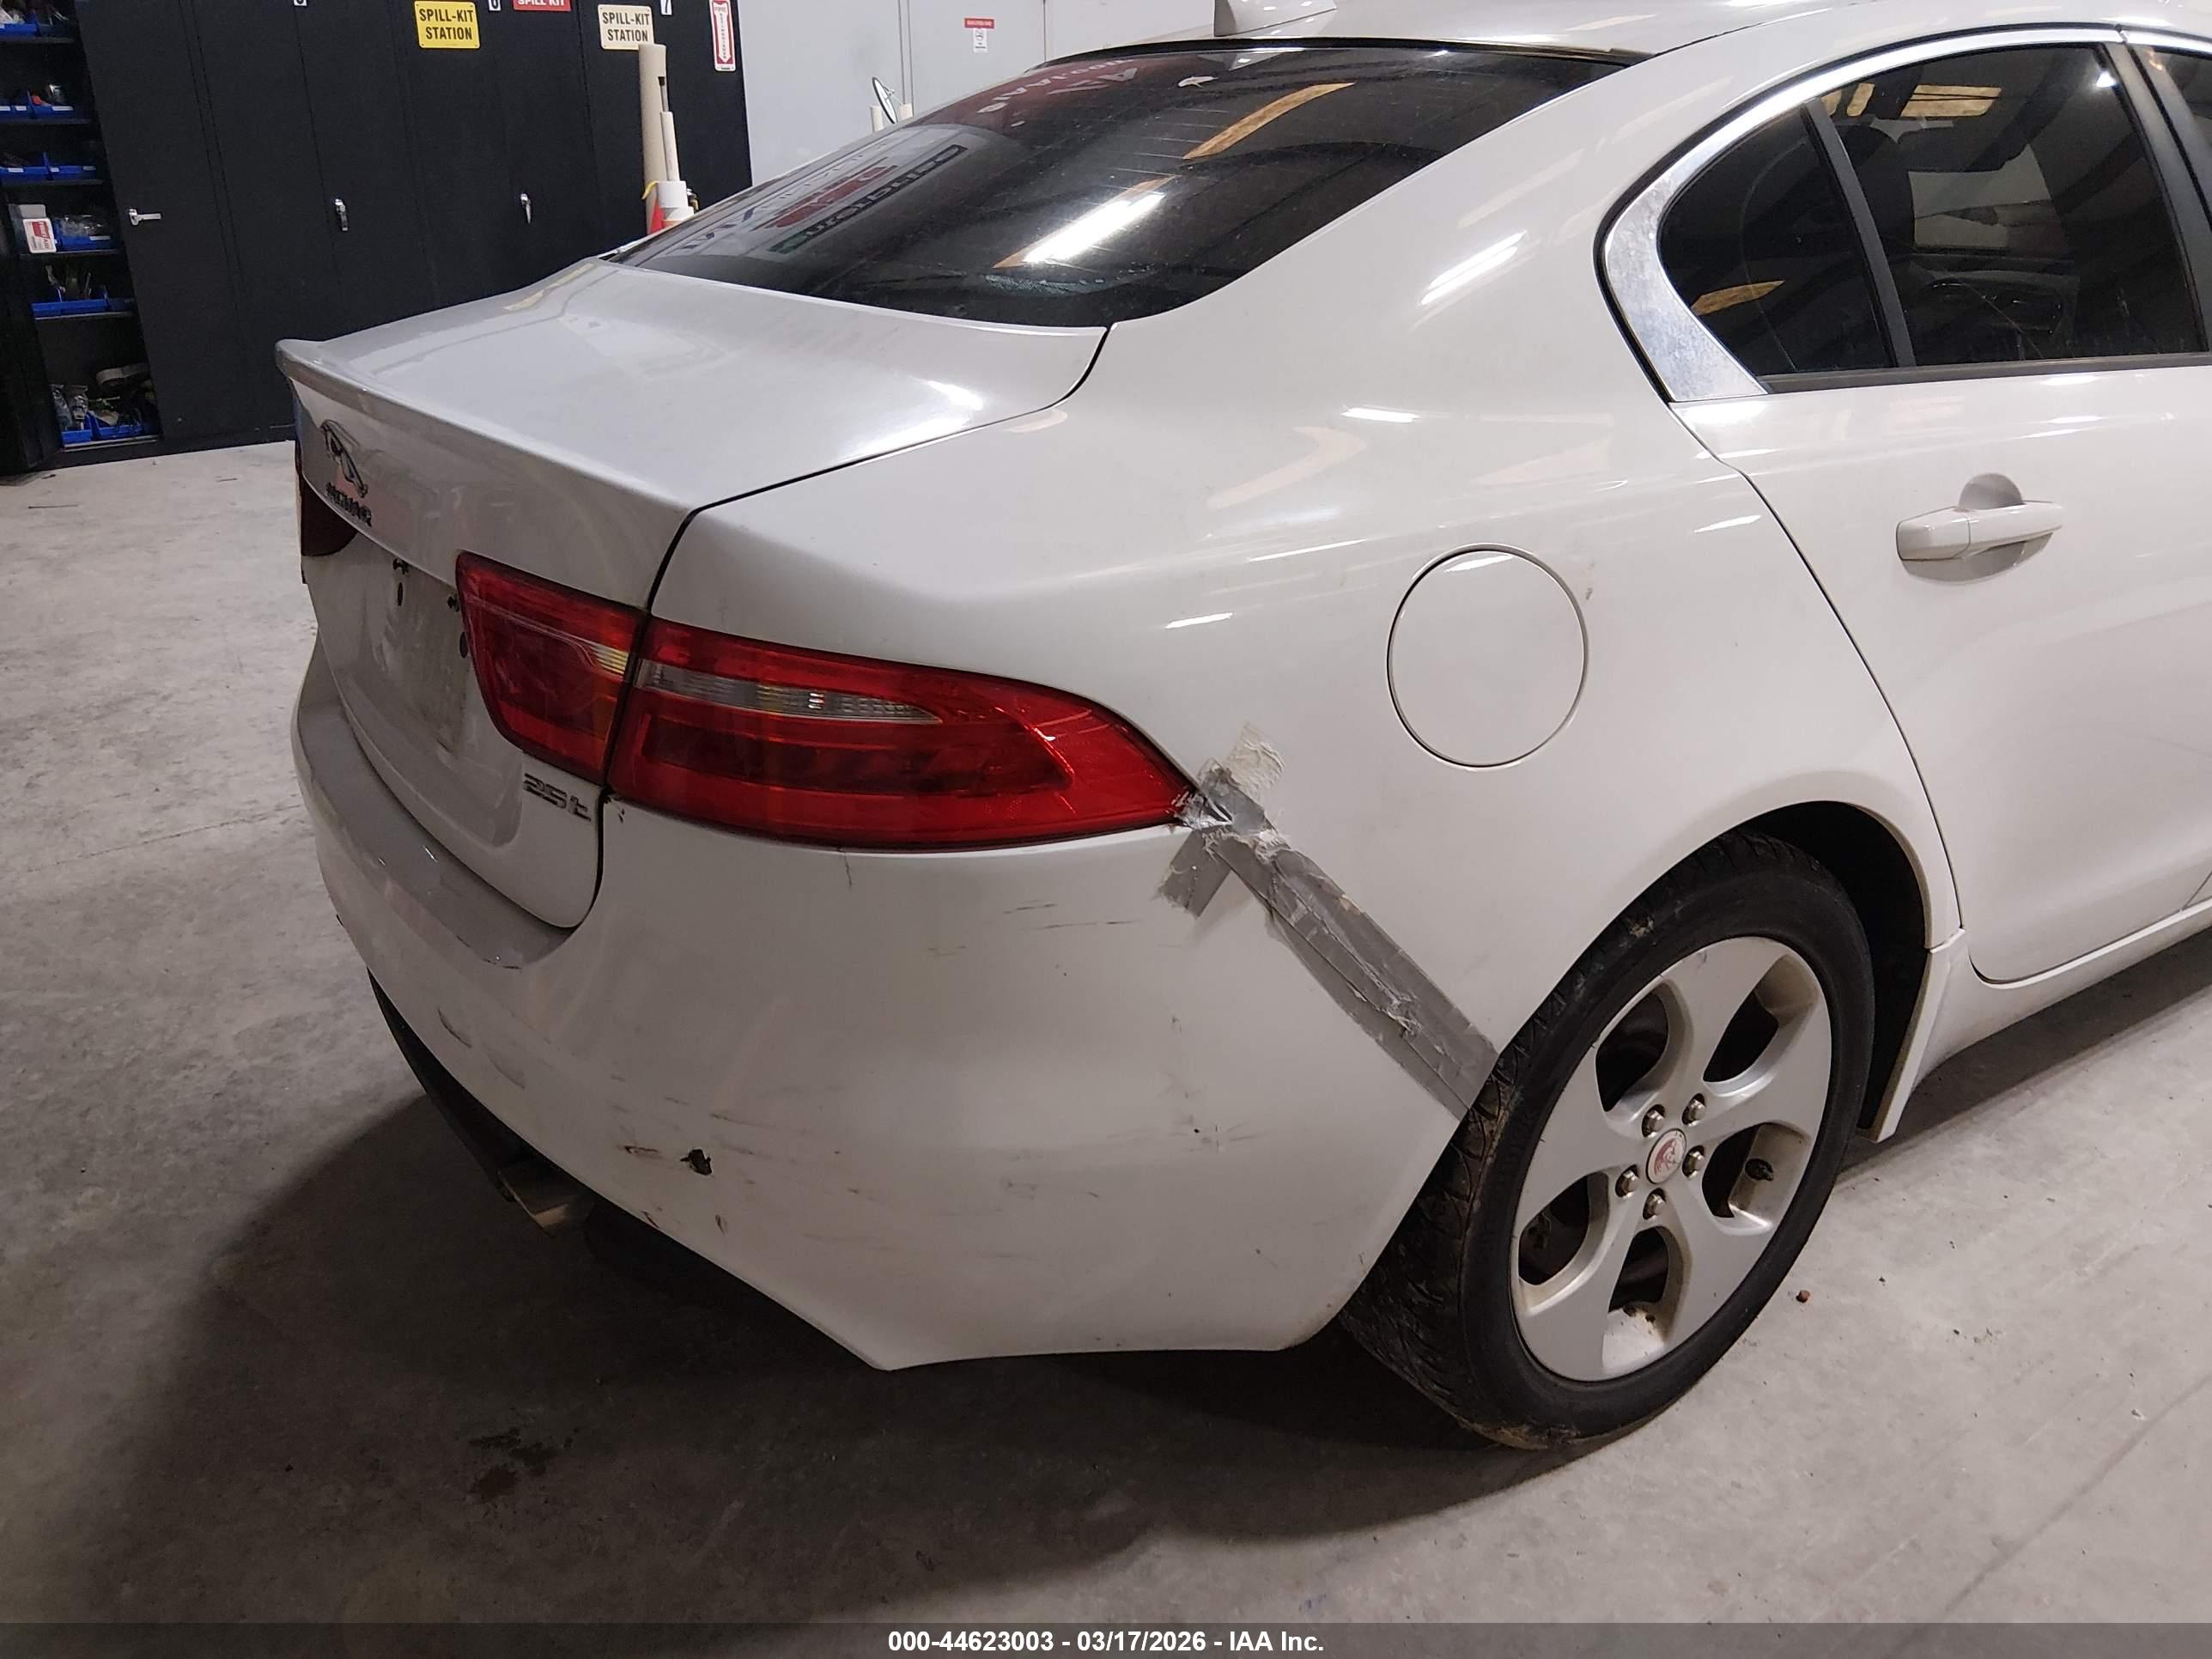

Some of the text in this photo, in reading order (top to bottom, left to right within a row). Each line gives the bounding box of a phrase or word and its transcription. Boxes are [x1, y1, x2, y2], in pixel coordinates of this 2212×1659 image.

[419, 8, 474, 23] SPILL-KIT
[602, 11, 650, 26] SPILL-KIT
[425, 26, 473, 40] STATION
[607, 28, 649, 42] STATION
